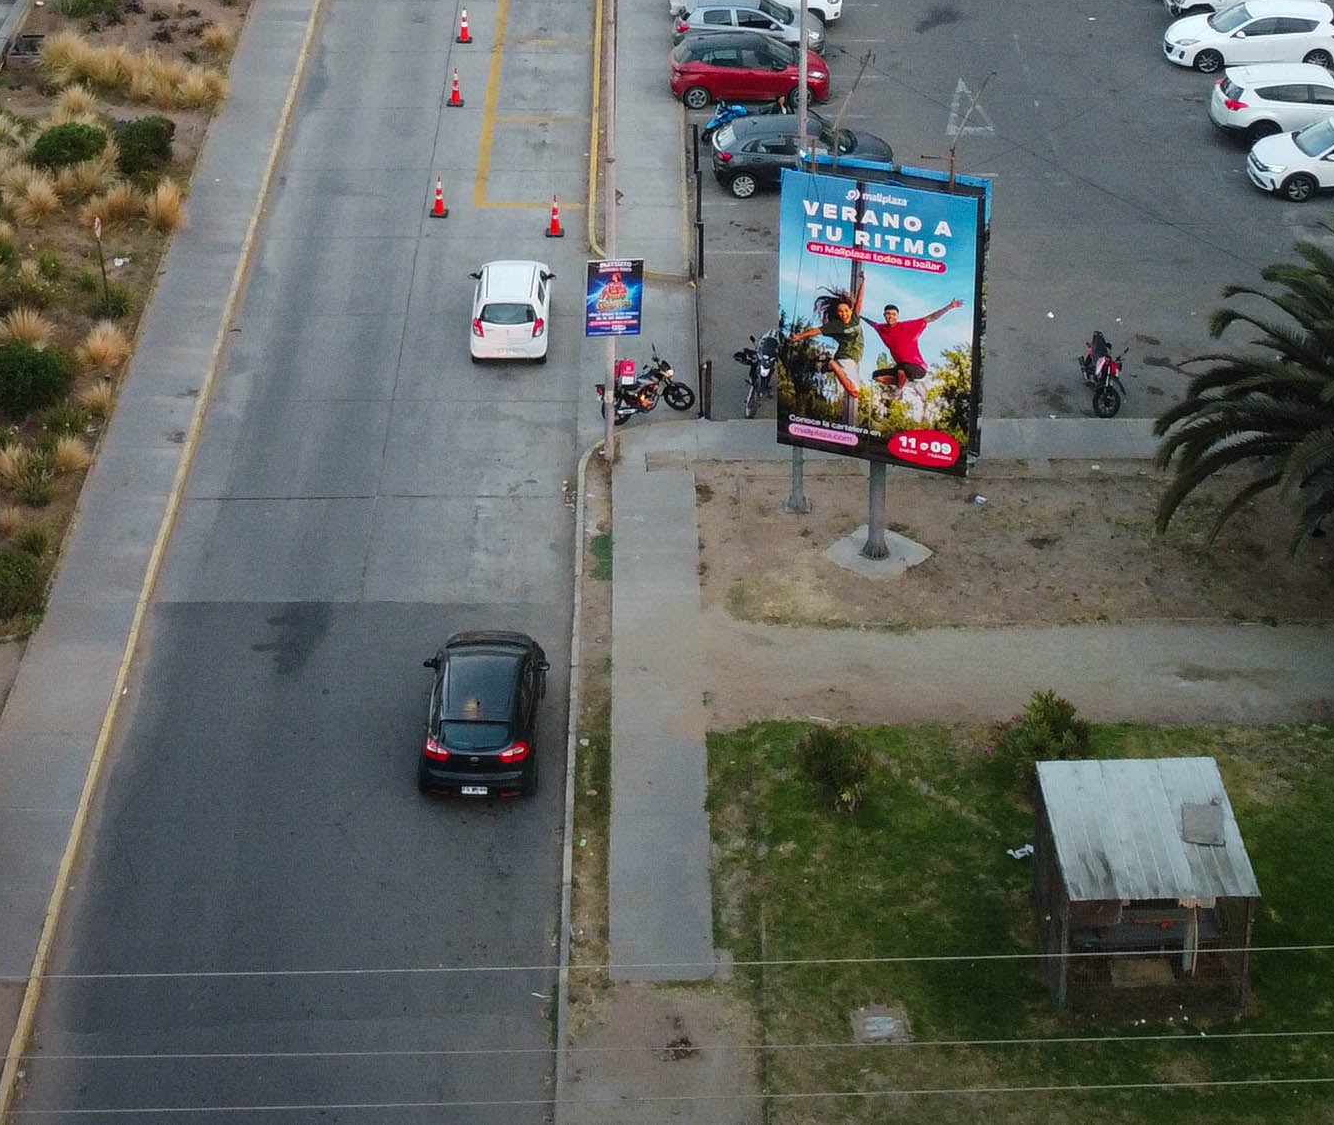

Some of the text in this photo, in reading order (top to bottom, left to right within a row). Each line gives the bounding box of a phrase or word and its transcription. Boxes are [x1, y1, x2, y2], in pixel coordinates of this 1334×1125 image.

[862, 192, 908, 207] mallplaza
[803, 200, 952, 237] VERANO A
[807, 223, 947, 258] TU RITMO
[810, 244, 942, 271] en Mallplaza todos a bailar
[788, 413, 821, 426] Conoce
[822, 419, 830, 429] la
[870, 429, 882, 437] en
[898, 435, 916, 449] 11
[930, 441, 952, 455] 09
